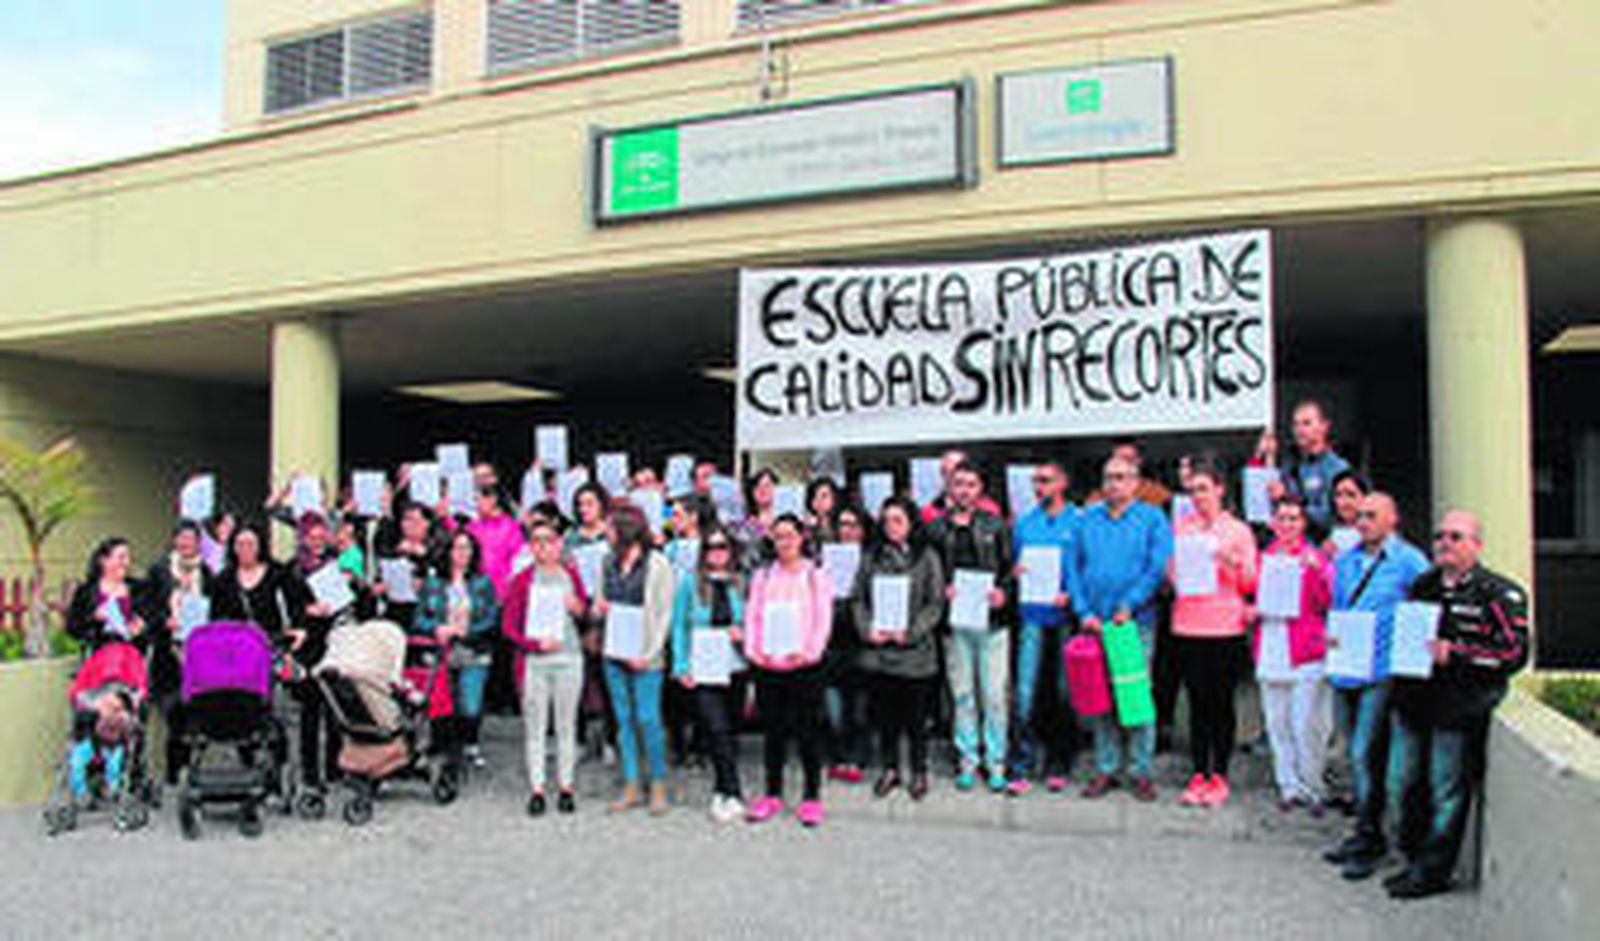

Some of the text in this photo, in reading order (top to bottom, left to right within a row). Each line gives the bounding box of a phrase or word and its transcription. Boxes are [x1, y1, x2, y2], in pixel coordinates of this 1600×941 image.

[761, 273, 973, 347] ESCUELA
[1192, 239, 1260, 302] DE
[1042, 309, 1266, 409] RECORTES
